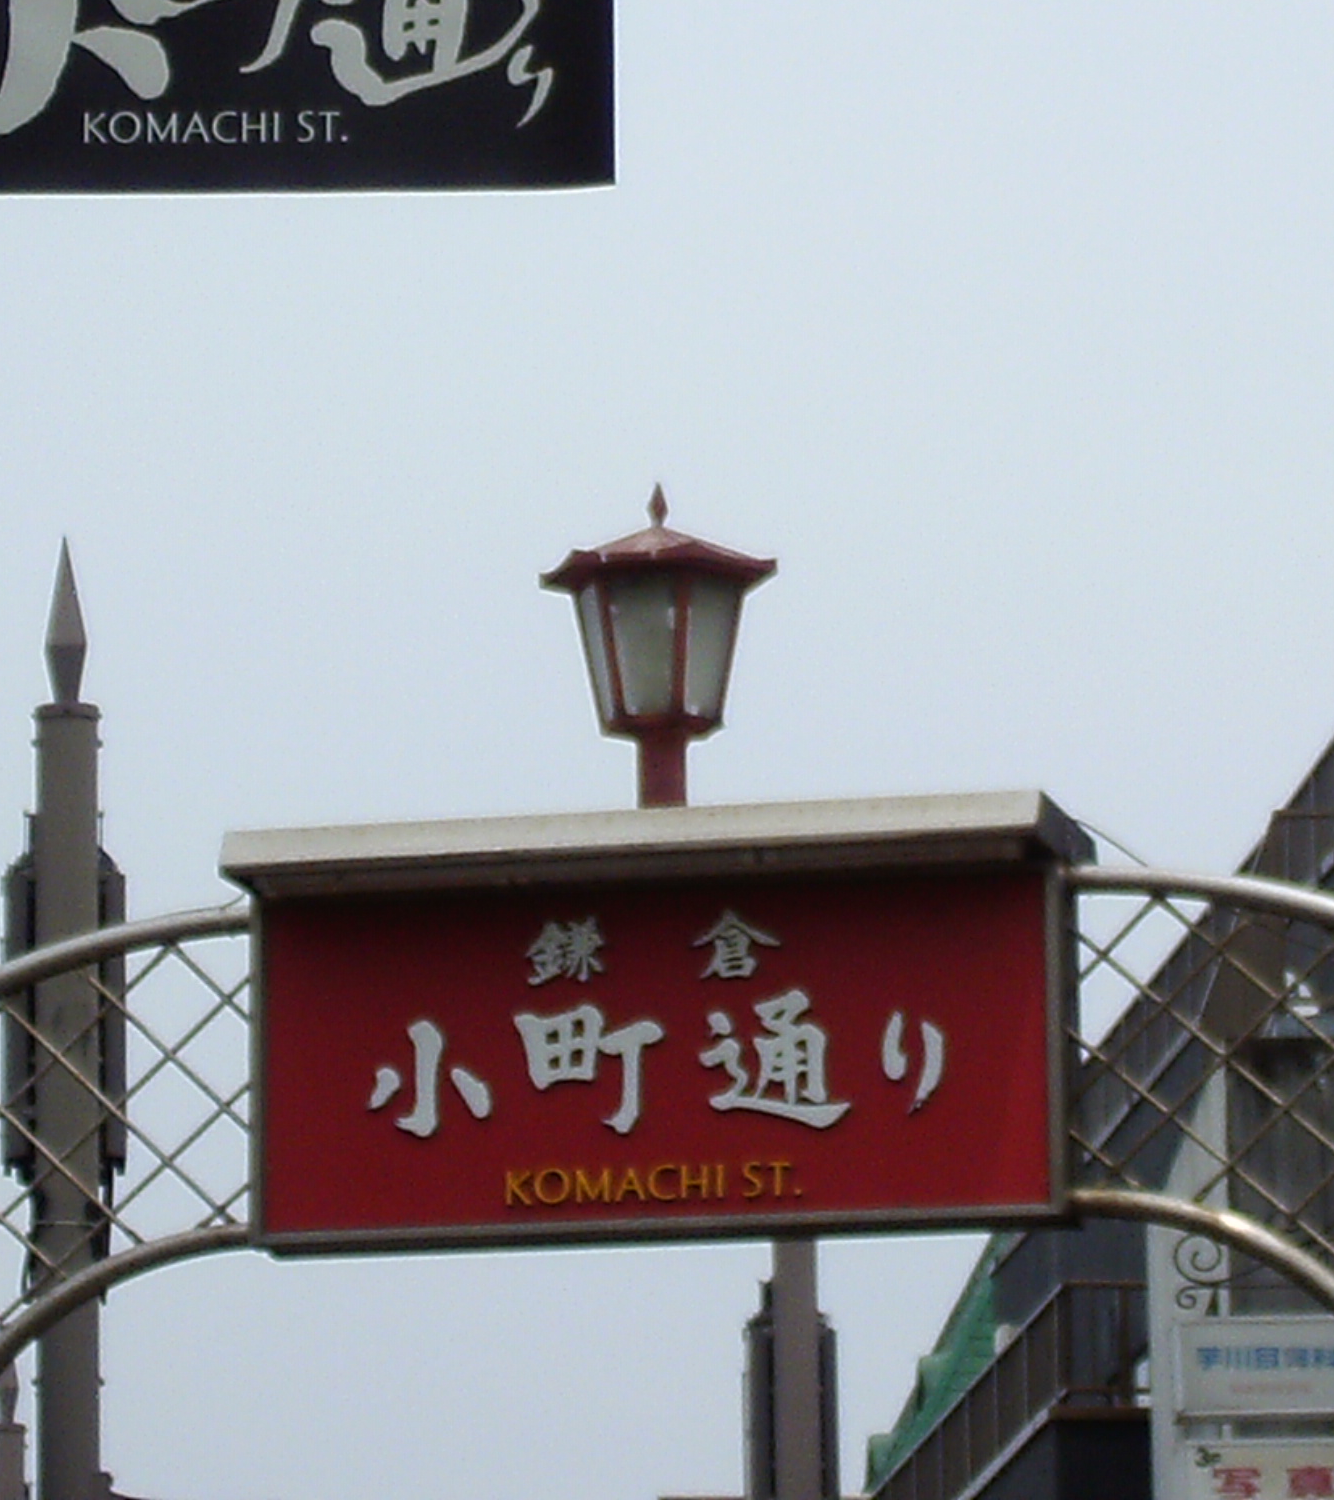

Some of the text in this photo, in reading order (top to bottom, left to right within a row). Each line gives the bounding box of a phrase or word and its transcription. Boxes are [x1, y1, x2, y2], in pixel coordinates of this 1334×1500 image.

[83, 110, 349, 144] KOMACHI ST.
[525, 910, 780, 986] 鎌倉
[367, 990, 946, 1138] 小町通り
[505, 1161, 802, 1206] KOMACHI ST.
